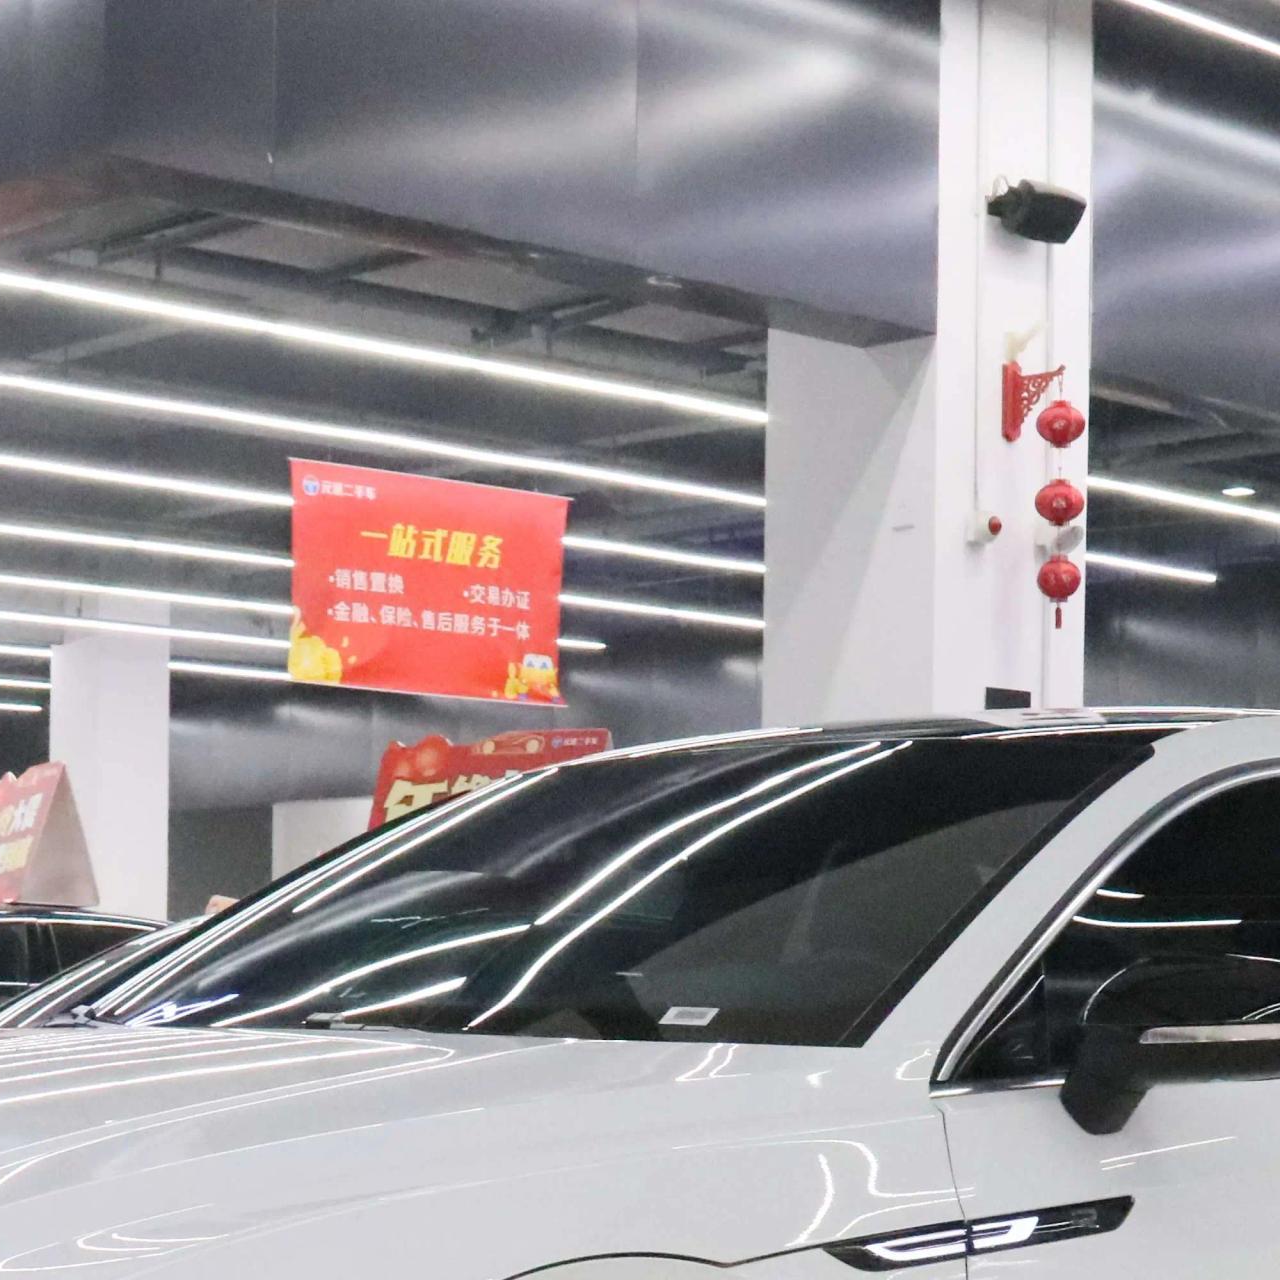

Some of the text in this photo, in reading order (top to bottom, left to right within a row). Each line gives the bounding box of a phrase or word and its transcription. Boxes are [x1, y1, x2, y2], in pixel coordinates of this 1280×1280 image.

[360, 523, 503, 569] 一站式服务
[335, 568, 530, 610] 销售置换 交易办证
